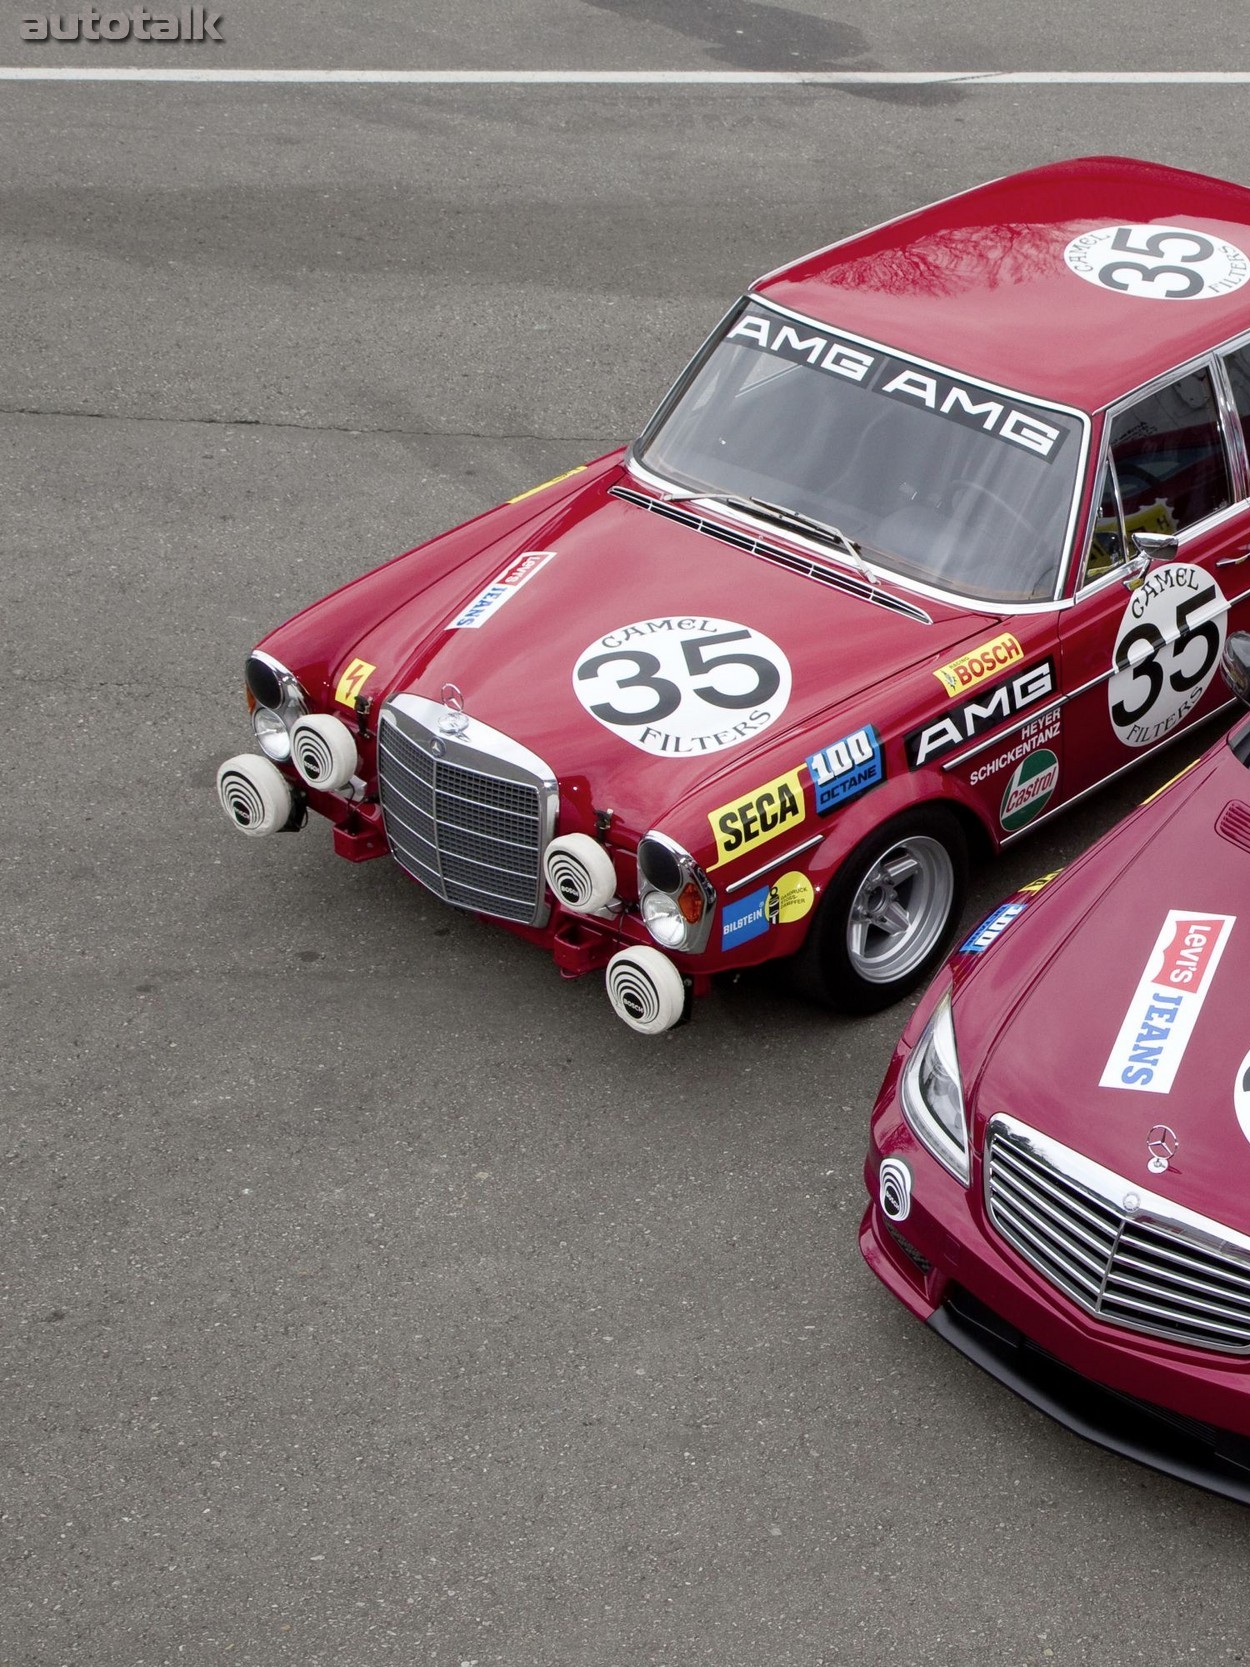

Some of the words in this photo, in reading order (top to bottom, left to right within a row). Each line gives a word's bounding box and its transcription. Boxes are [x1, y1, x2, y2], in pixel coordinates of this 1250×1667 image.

[1069, 233, 1111, 273] CAMEL
[1098, 227, 1215, 299] 35
[1208, 244, 1247, 293] FILTERS
[727, 315, 875, 382] AMG
[881, 370, 1061, 457] AMG
[457, 587, 508, 626] JEANS
[1131, 567, 1199, 618] CAMEL
[601, 618, 718, 649] CAMEL
[1111, 584, 1220, 728] 35
[577, 629, 781, 726] 35
[953, 638, 1020, 686] BOSCH
[638, 709, 771, 753] FILTERS
[916, 662, 1052, 766] AMG
[1021, 707, 1061, 741] HEYER
[1126, 686, 1203, 743] FILTERS
[811, 729, 874, 786] 100
[970, 722, 1061, 786] SCHICKENTANZ
[820, 764, 877, 805] OCTANE
[1006, 766, 1057, 814] Castrol
[718, 782, 800, 852] SECA
[723, 908, 763, 936] BILSTEIN
[623, 998, 644, 1013] BOSCH
[1121, 992, 1183, 1086] JEANS
